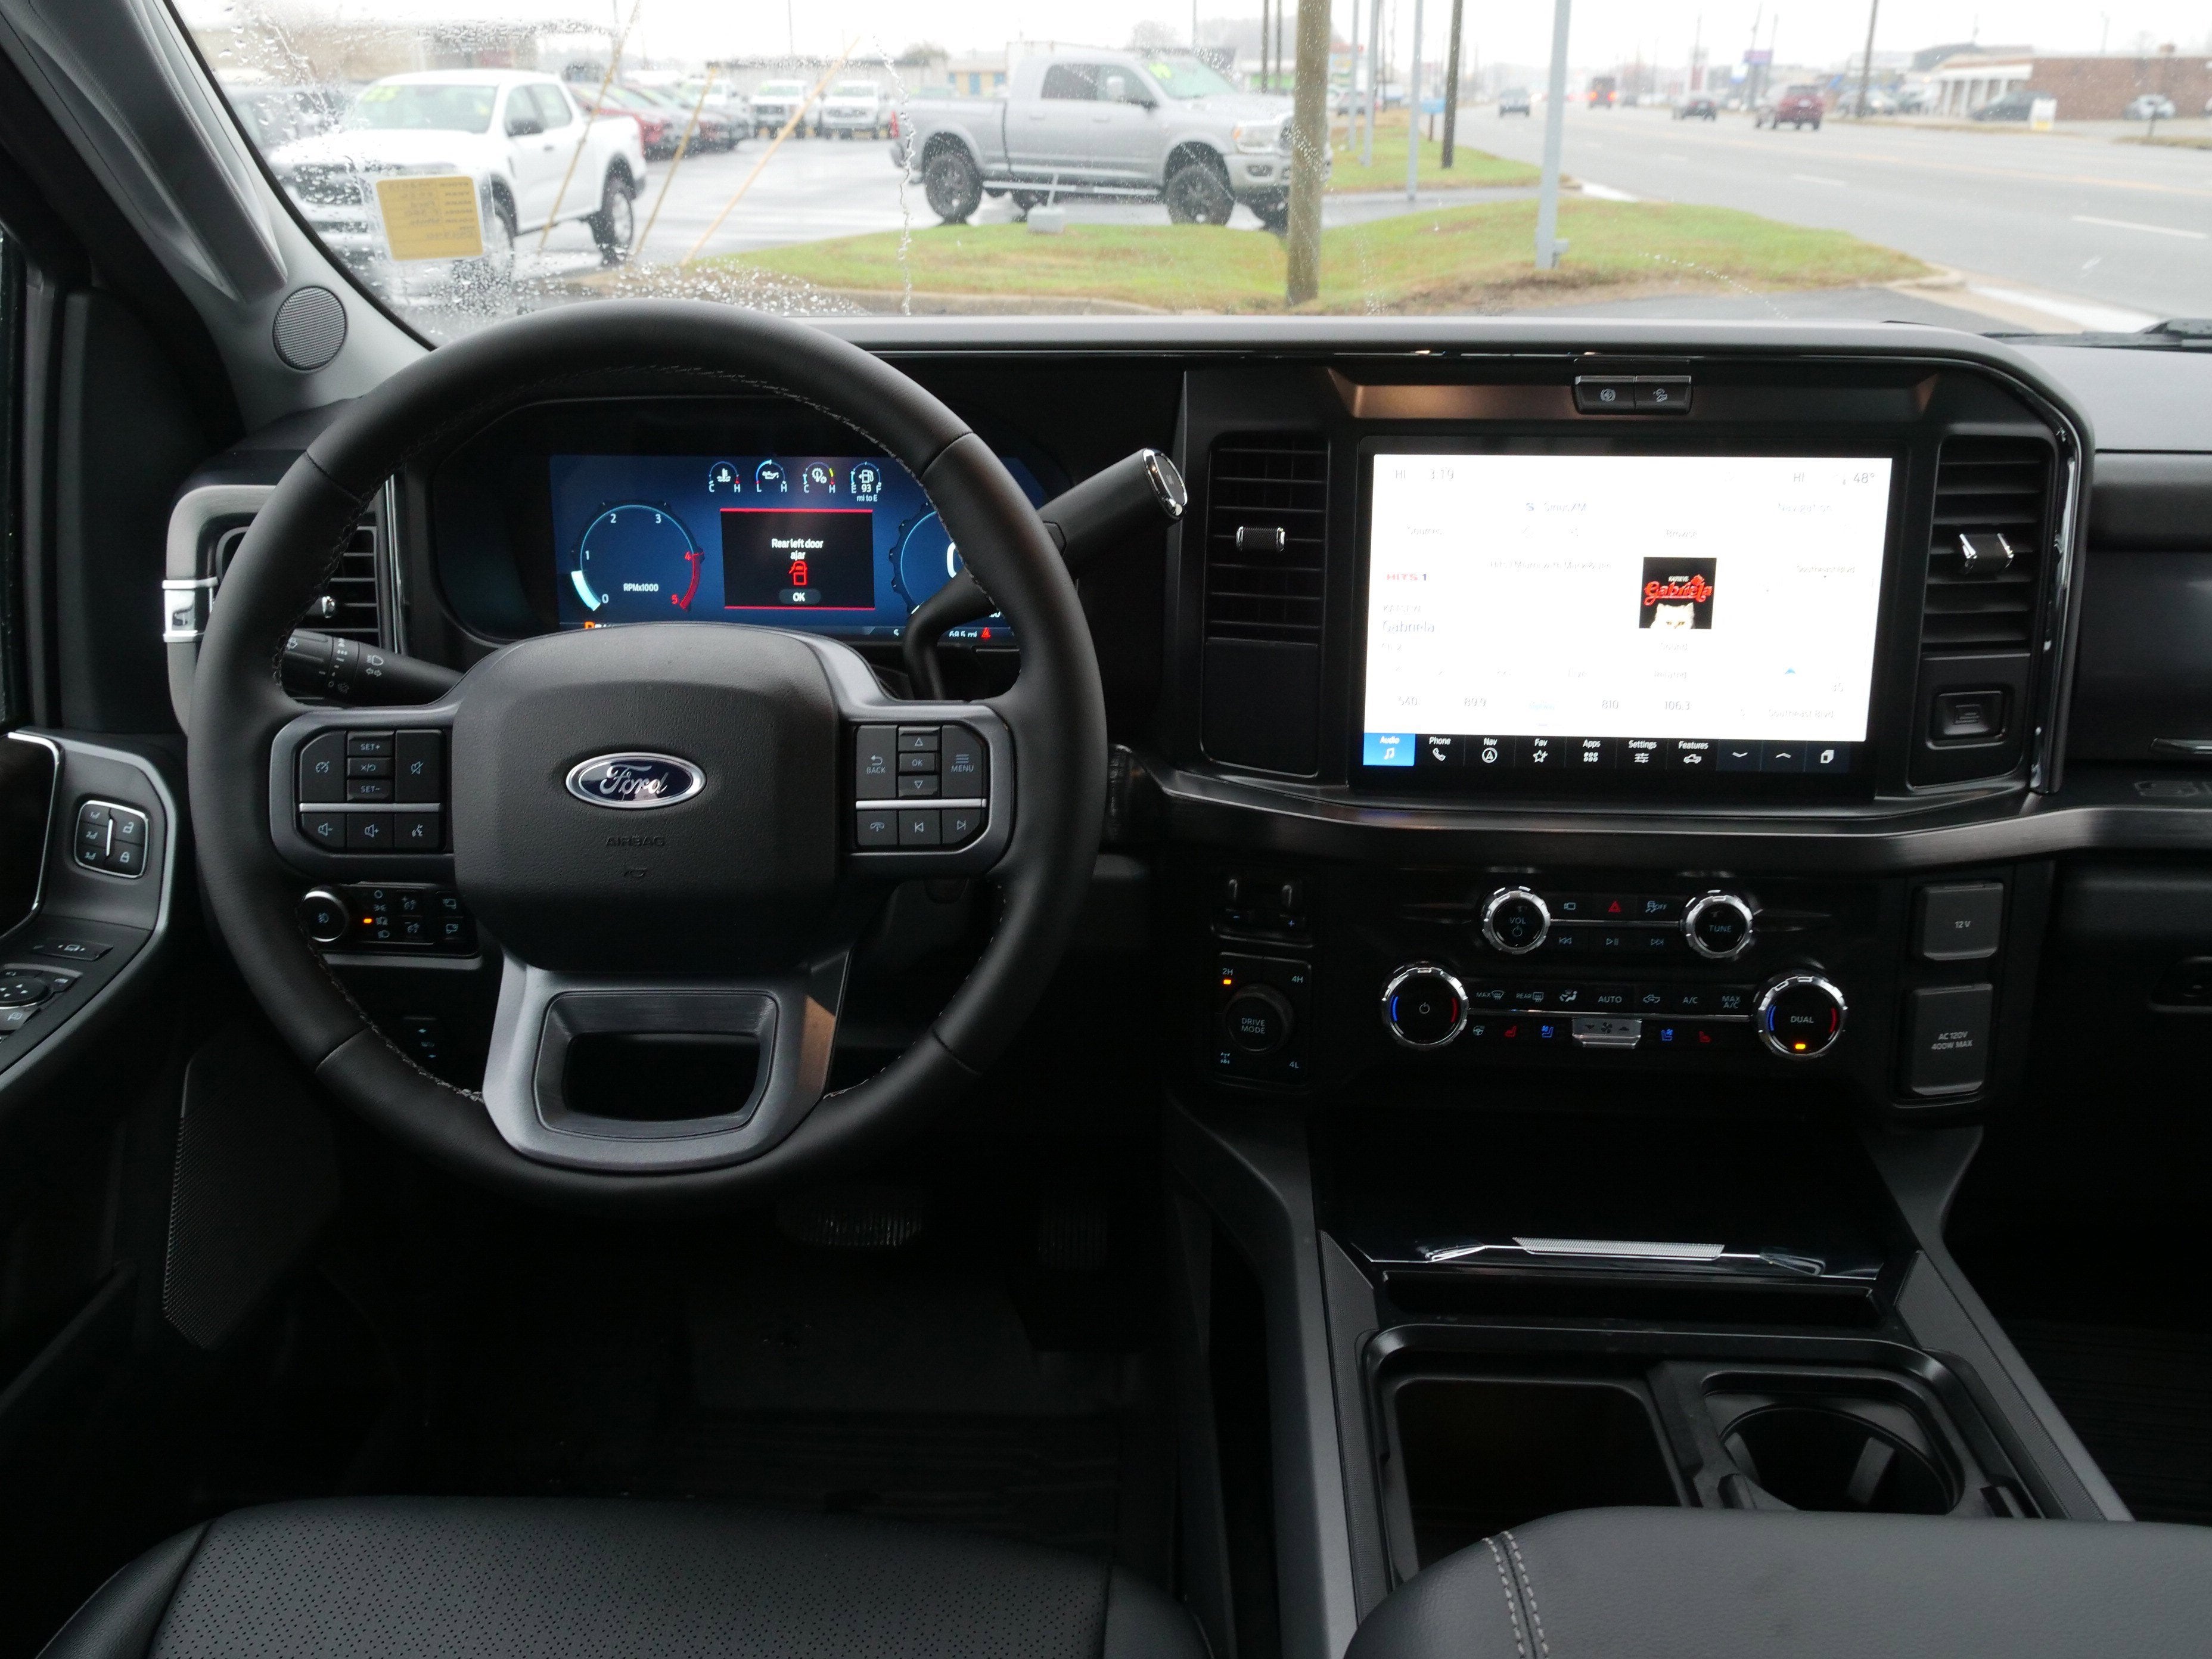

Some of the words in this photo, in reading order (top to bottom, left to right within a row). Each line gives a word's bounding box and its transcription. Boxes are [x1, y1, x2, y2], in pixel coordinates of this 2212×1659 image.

[709, 484, 714, 493] C
[734, 484, 740, 493] H
[757, 484, 762, 493] L
[781, 484, 787, 492] H
[829, 484, 835, 493] H
[851, 485, 856, 493] E
[862, 484, 871, 493] 93
[610, 514, 616, 523] 2
[655, 514, 661, 523] 3
[771, 538, 790, 548] Rear
[790, 538, 804, 548] left
[805, 538, 824, 548] door
[585, 551, 589, 560] 1
[685, 551, 692, 560] 4
[790, 550, 806, 561] ajar
[1422, 573, 1428, 582] 1
[623, 583, 658, 592] RPMx1000
[1644, 574, 1713, 606] Gabriela
[602, 594, 609, 604] 0
[671, 594, 678, 604] 5
[793, 592, 805, 602] OK
[1429, 737, 1451, 745] Phone
[1534, 738, 1548, 747] Fav
[1583, 740, 1601, 748] Apps
[1628, 740, 1657, 750] Settings
[1679, 741, 1708, 749] Features
[599, 764, 668, 796] Ford
[605, 837, 665, 847] AIRBAG
[1241, 1017, 1265, 1027] DRIVE
[1791, 1015, 1814, 1024] DUAL
[1241, 1026, 1265, 1034] MODE
